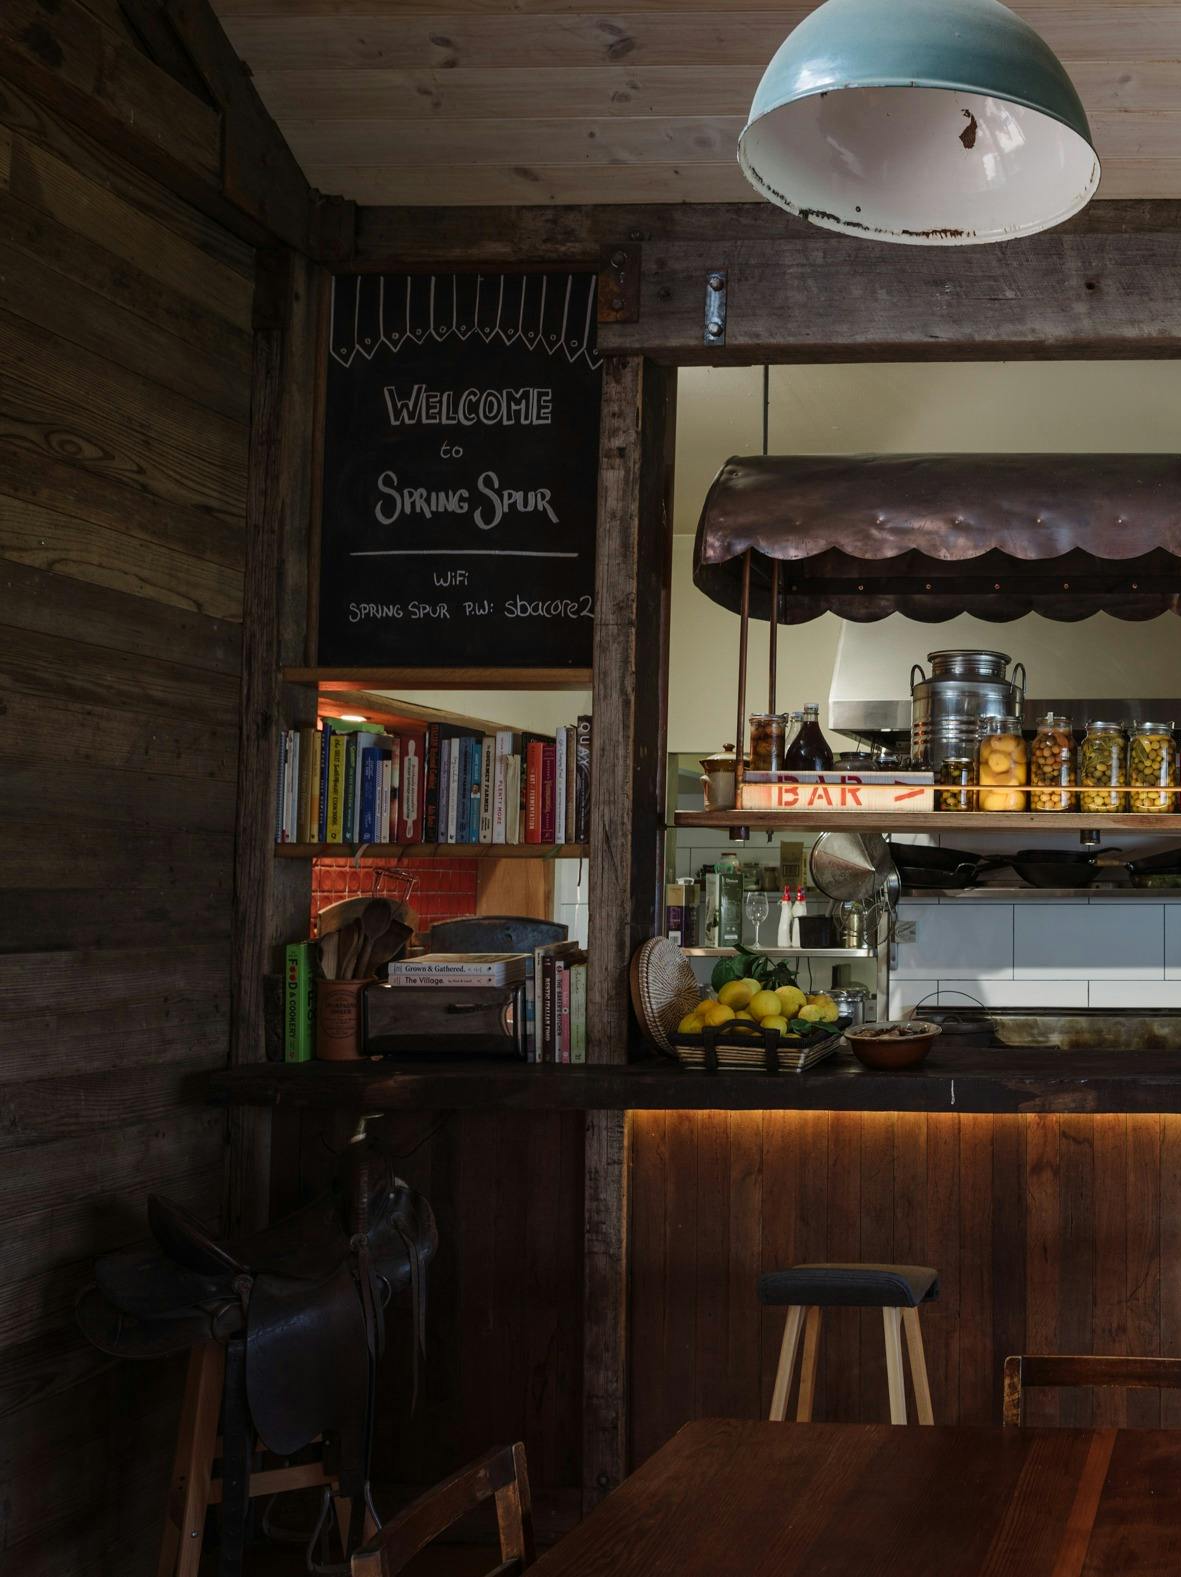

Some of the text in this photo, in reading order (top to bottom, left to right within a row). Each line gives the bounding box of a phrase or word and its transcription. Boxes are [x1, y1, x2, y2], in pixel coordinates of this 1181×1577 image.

[383, 383, 553, 426] WELCOME
[439, 440, 464, 459] to
[374, 470, 560, 530] SPRING SPUR
[433, 570, 469, 587] WiFi
[348, 602, 404, 623] SPRING
[408, 602, 451, 619] SPUR
[504, 594, 595, 619] sbacore2
[777, 774, 863, 807] BAR
[405, 965, 428, 973] Grown
[434, 965, 466, 973] Gathered.
[405, 976, 418, 984] The
[288, 1000, 297, 1039] COOKERY
[543, 1000, 551, 1024] ITALIAN
[543, 1025, 551, 1042] FOOD
